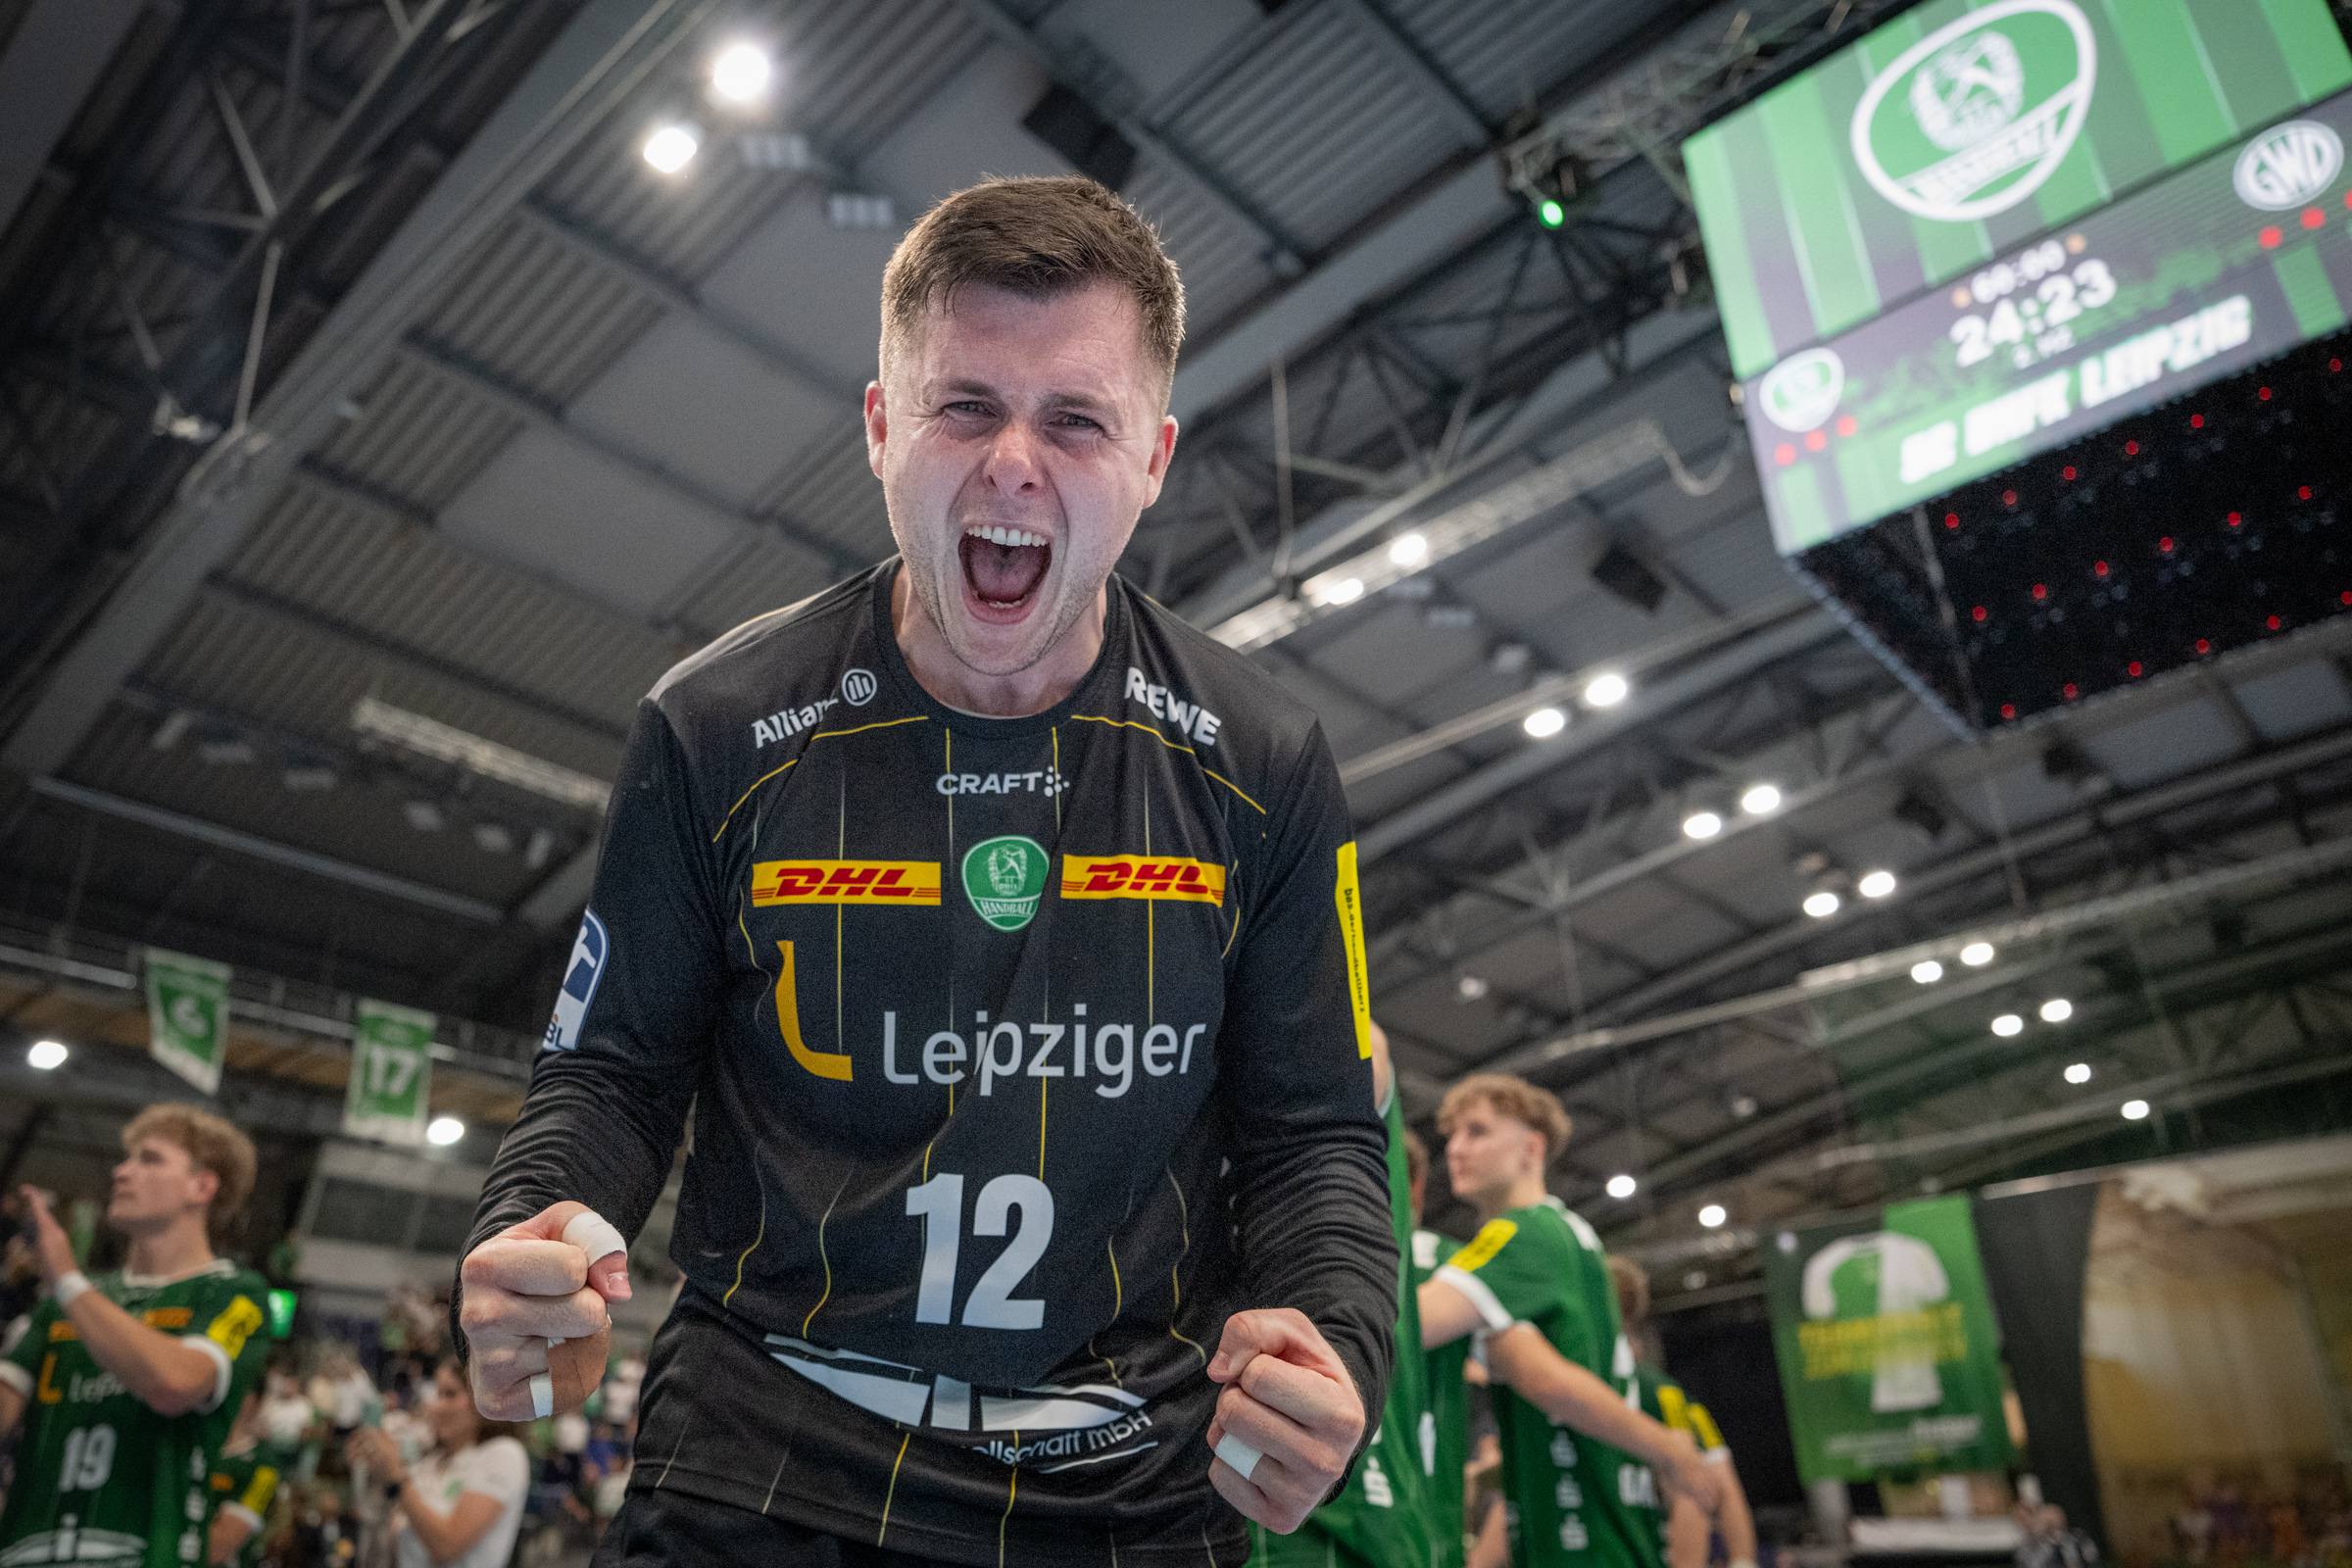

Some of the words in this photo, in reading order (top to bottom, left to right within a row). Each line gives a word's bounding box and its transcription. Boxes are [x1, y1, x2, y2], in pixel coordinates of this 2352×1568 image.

[2244, 127, 2333, 206] GWD
[1949, 258, 2118, 368] 24:23
[751, 698, 840, 749] Allian
[1124, 666, 1222, 746] REWE
[936, 772, 1043, 796] CRAFT
[774, 868, 920, 898] DHL
[980, 901, 1034, 915] HANDBALL
[1083, 862, 1213, 894] DHL
[368, 1045, 418, 1096] 17
[883, 1004, 1206, 1099] Leipziger
[906, 1172, 1055, 1330] 12
[58, 1423, 117, 1493] 19
